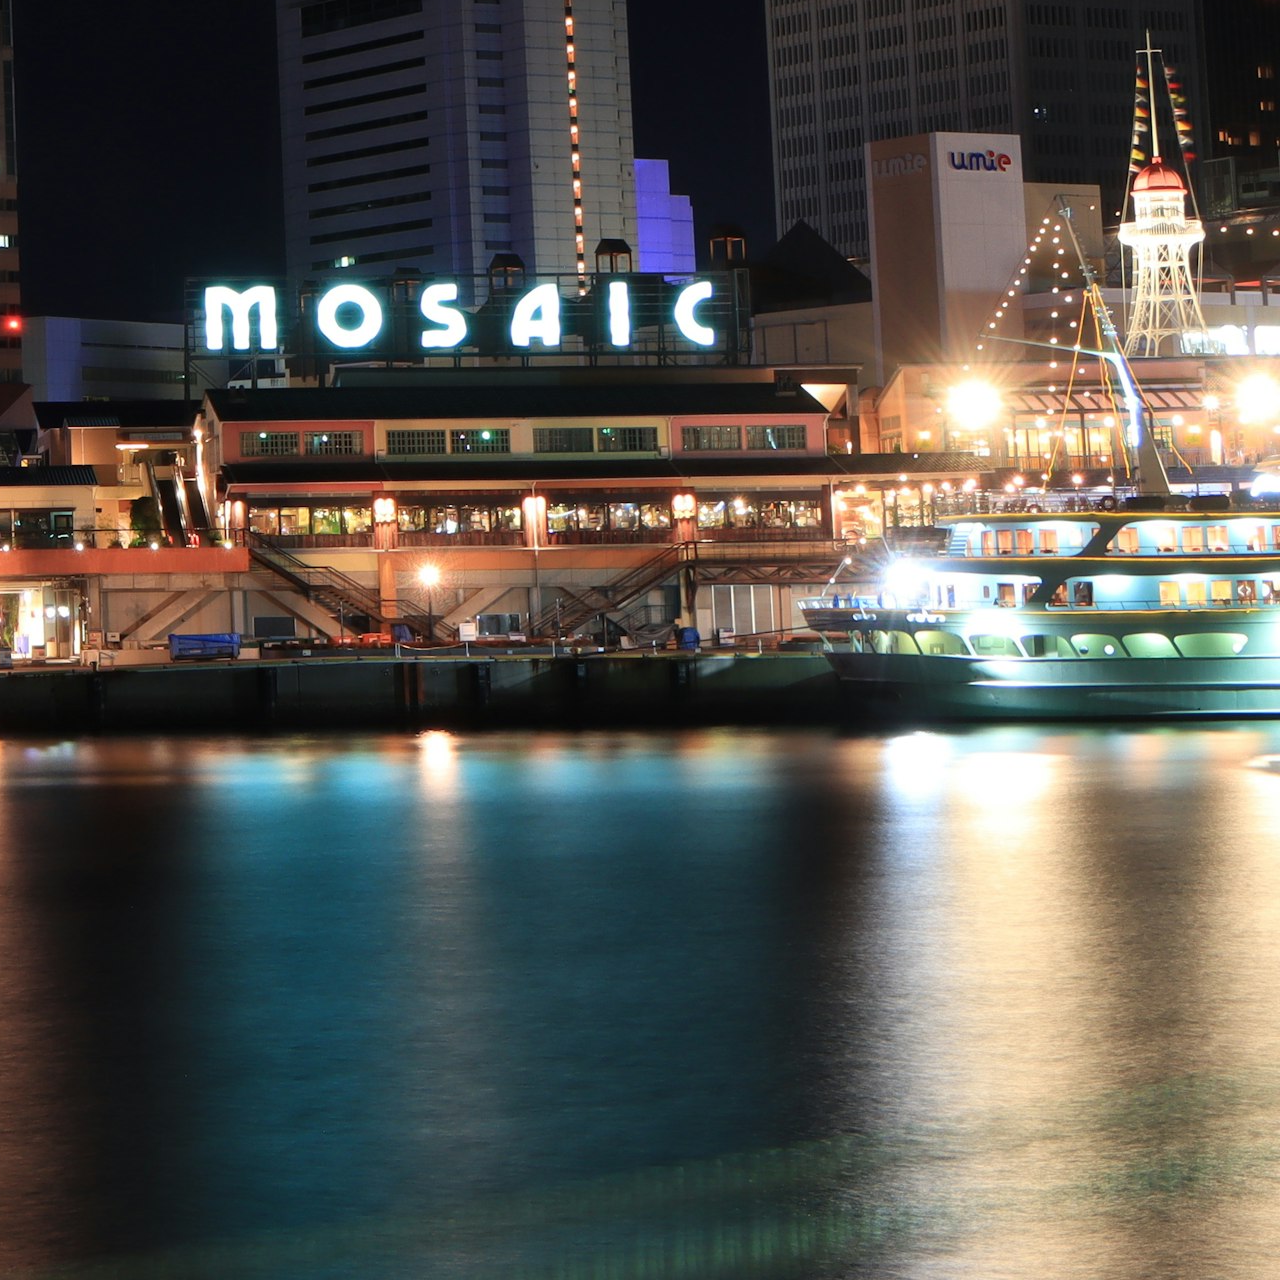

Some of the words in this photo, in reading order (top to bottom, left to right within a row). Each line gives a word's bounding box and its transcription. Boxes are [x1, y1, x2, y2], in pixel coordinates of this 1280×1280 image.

[873, 152, 927, 176] umie
[949, 150, 1012, 172] umie
[204, 281, 716, 351] MOSAIC
